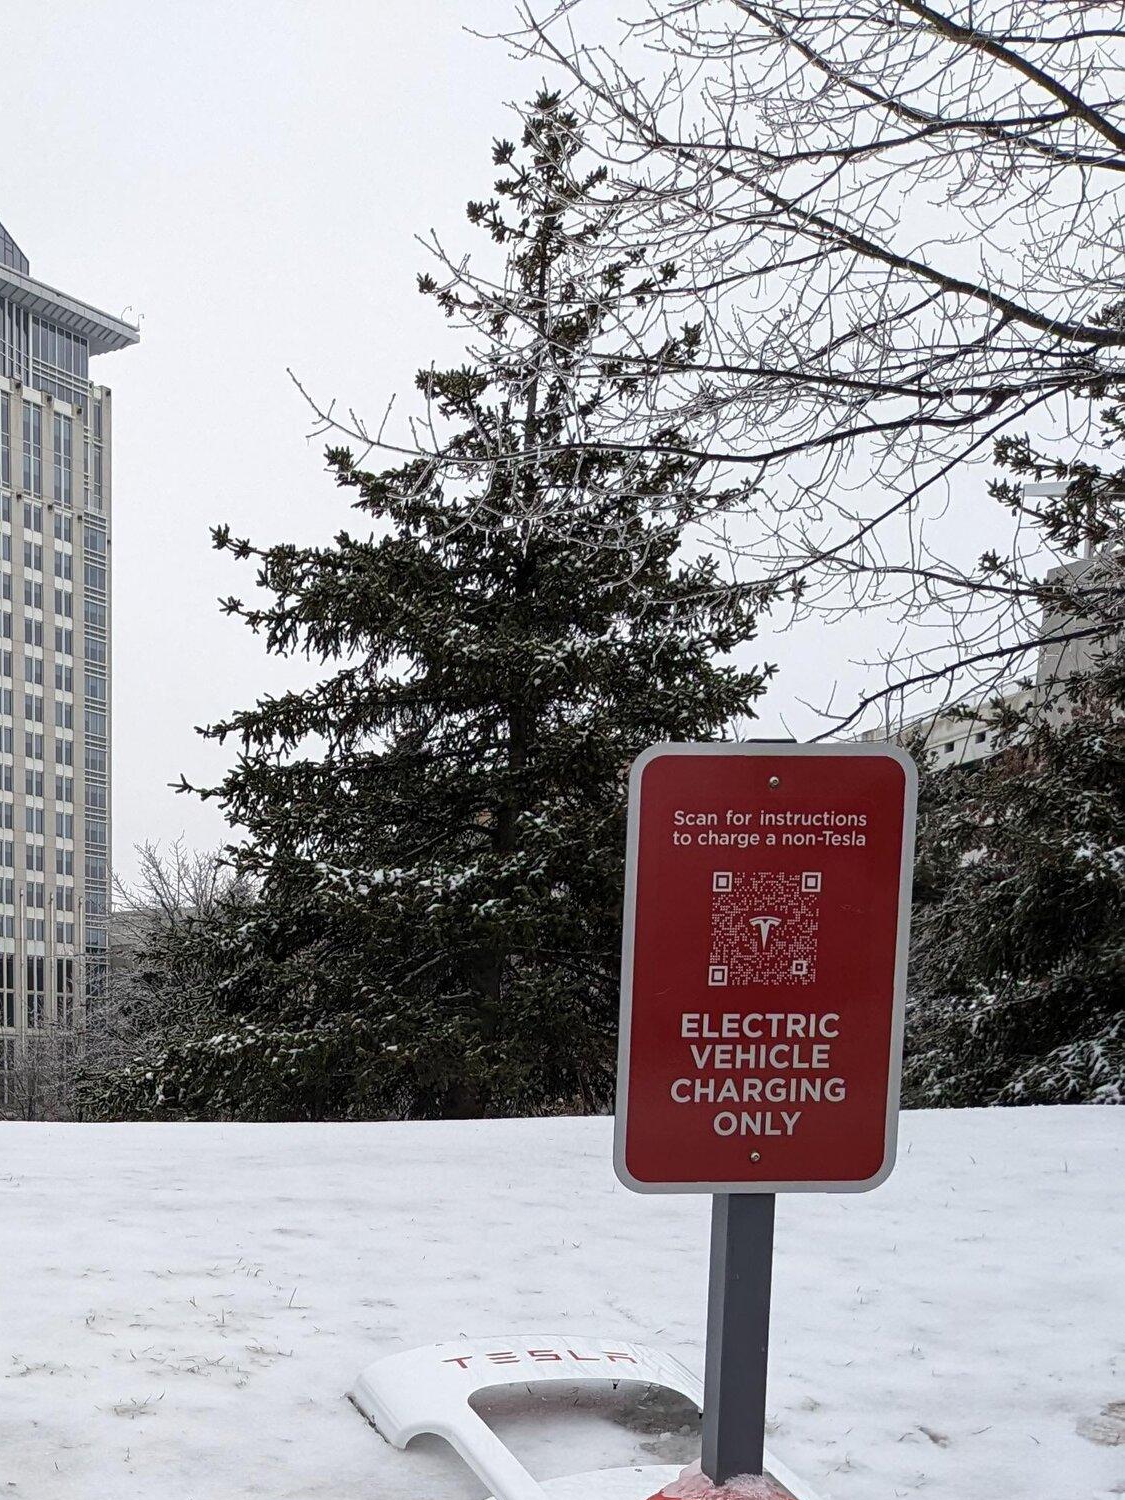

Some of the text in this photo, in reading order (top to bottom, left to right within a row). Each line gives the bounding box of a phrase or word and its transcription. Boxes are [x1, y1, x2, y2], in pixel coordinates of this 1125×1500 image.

[673, 809, 867, 826] Scan for instructions
[672, 830, 866, 848] to charge a non-Tesla
[681, 1013, 841, 1038] ELECTRIC
[690, 1044, 831, 1069] VEHICLE
[670, 1077, 847, 1103] CHARGING
[713, 1111, 802, 1136] ONLY
[441, 1349, 638, 1369] TESLA
